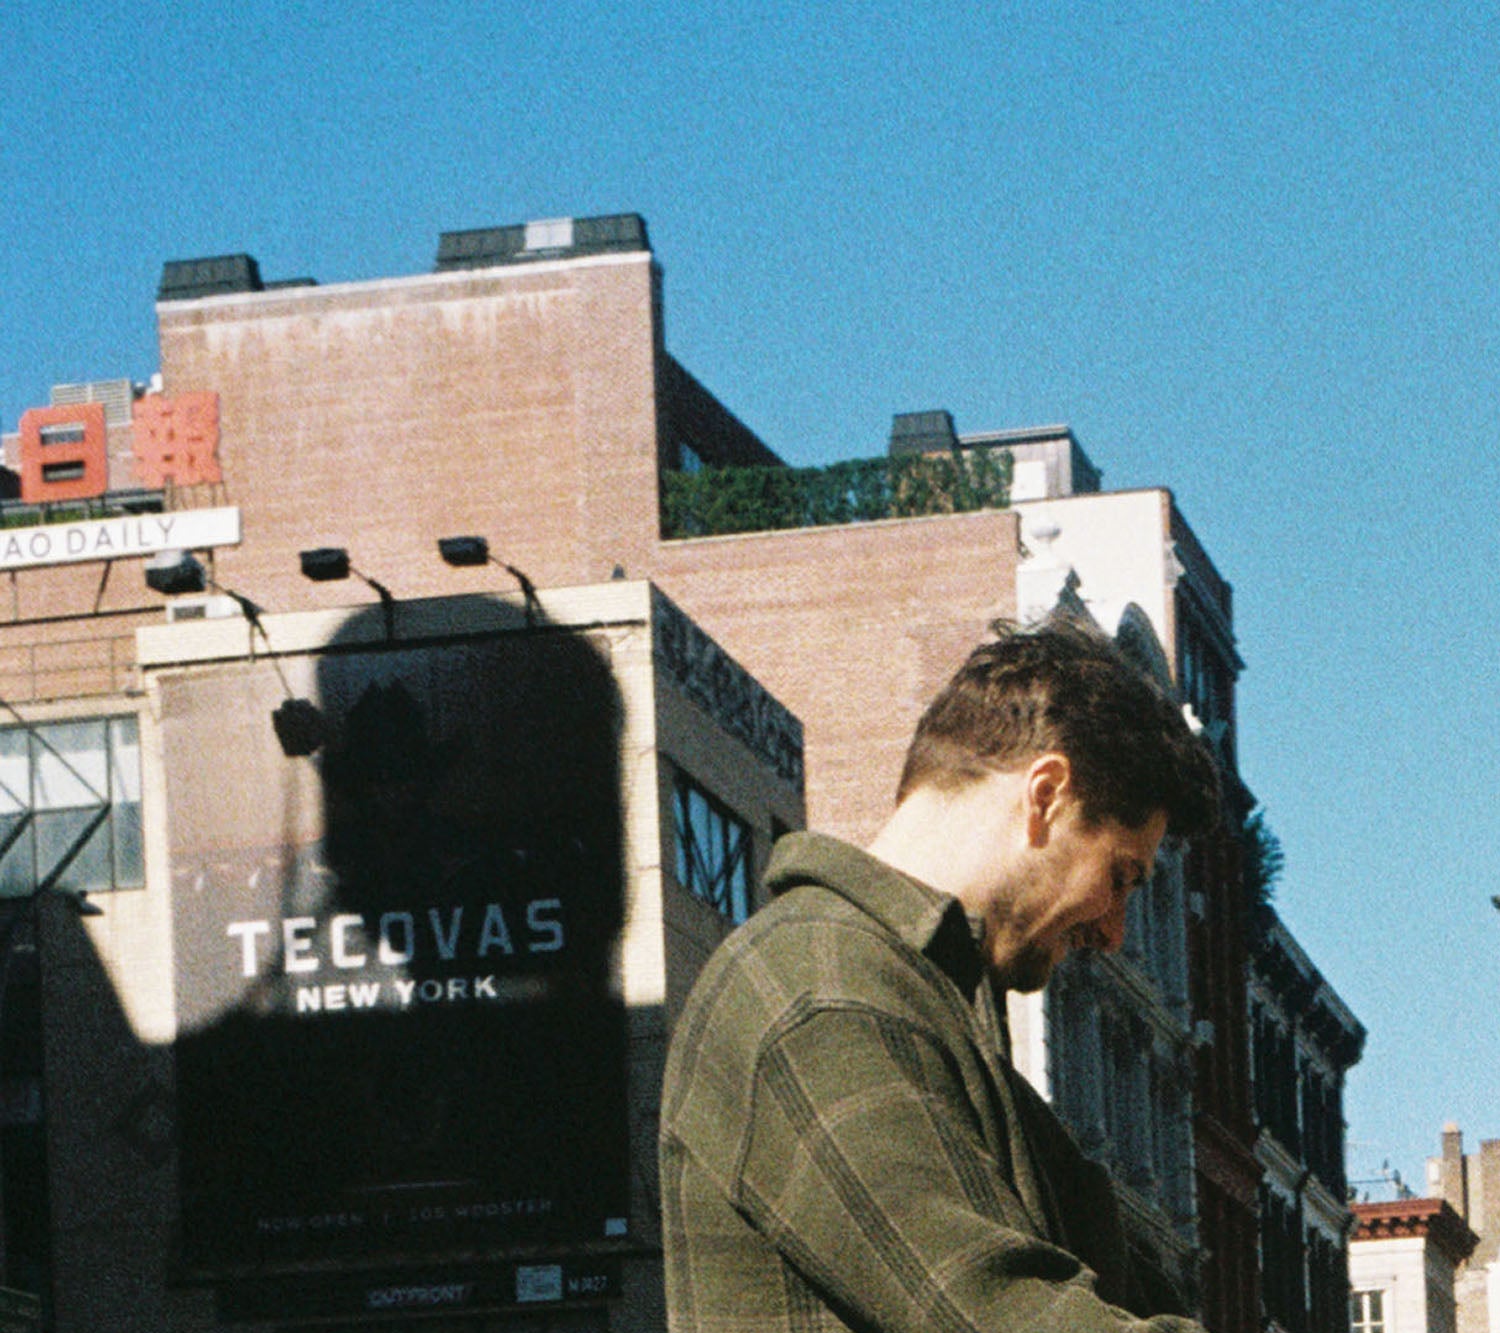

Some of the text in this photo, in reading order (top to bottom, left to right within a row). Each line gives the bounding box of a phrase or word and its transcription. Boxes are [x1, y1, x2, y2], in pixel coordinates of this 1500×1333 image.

[66, 518, 175, 555] DAILY
[227, 898, 564, 977] TECOVAS
[296, 975, 498, 1012] NEW YORK
